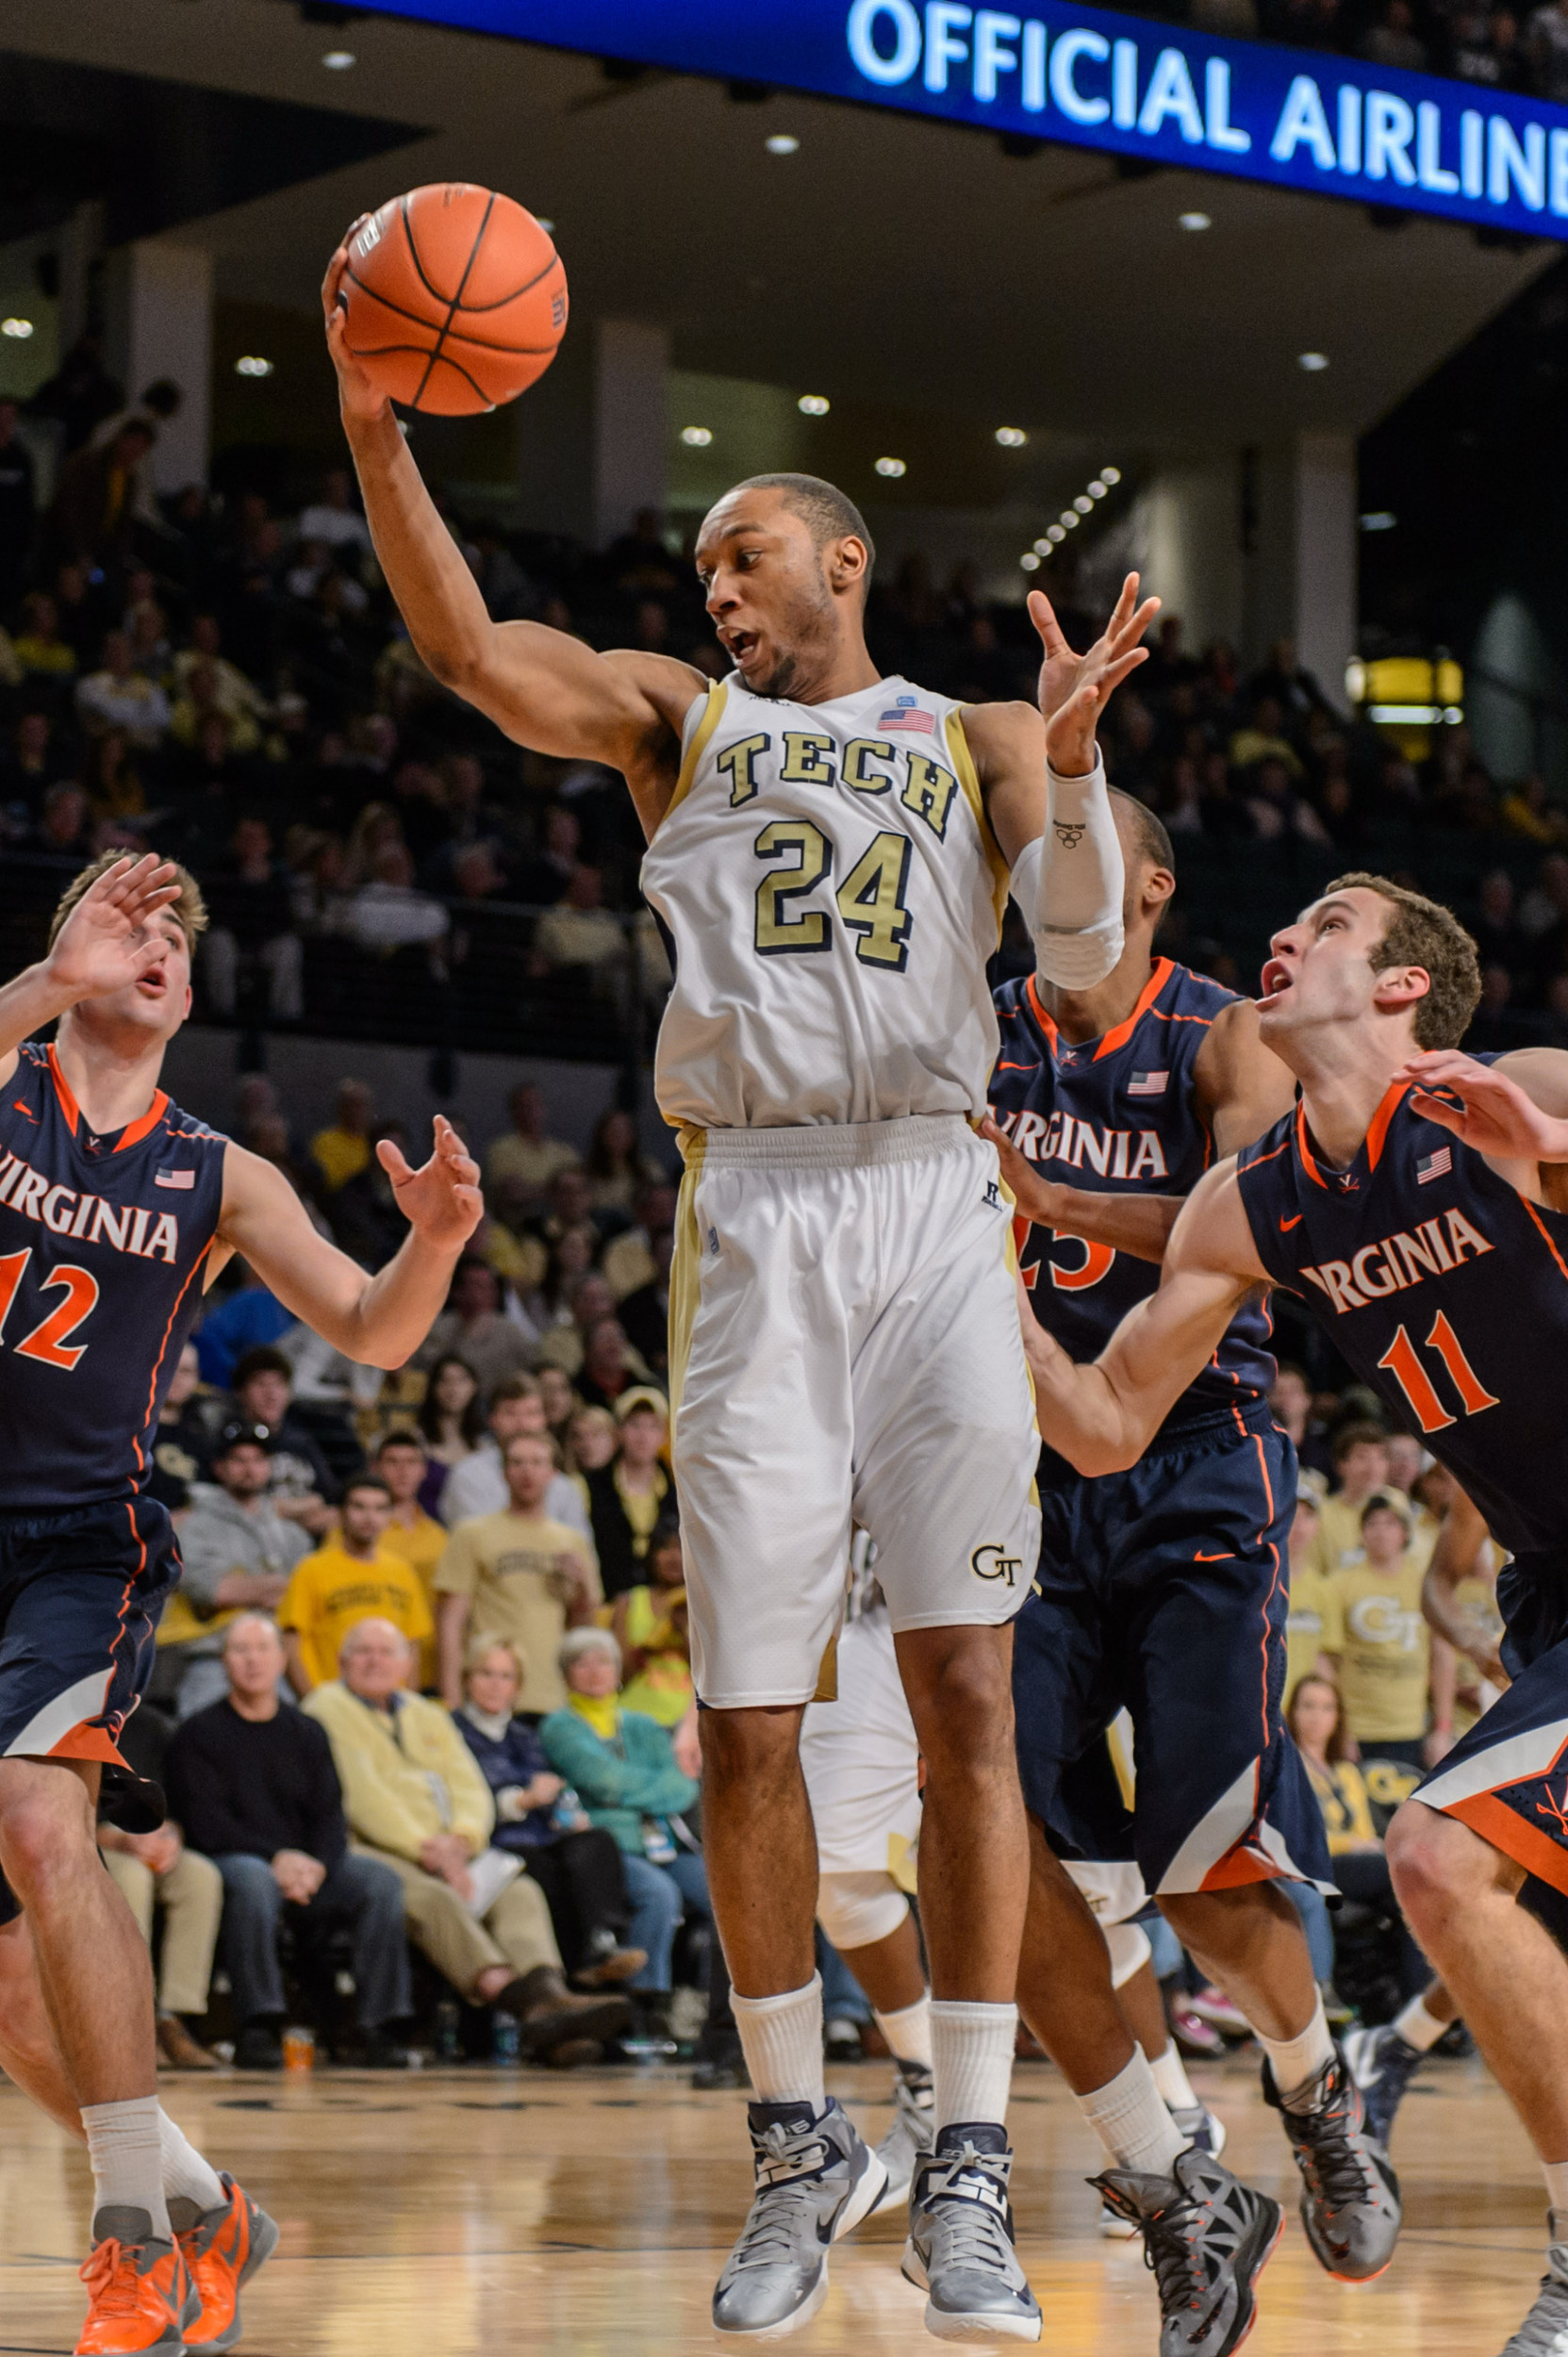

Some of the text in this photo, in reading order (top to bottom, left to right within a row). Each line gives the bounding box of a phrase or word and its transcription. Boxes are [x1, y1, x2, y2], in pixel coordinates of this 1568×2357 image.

[847, 0, 1252, 154] OFFICIAL
[717, 732, 959, 845] TECH
[753, 820, 914, 974] 24
[986, 1103, 1170, 1179] RGINIA
[0, 1144, 179, 1265] IRGINIA
[1013, 1215, 1116, 1292] 5
[1298, 1207, 1496, 1315] RGINIA
[1378, 1309, 1501, 1434] 11
[969, 1543, 1023, 1588] GT
[1349, 1594, 1424, 1652] GT
